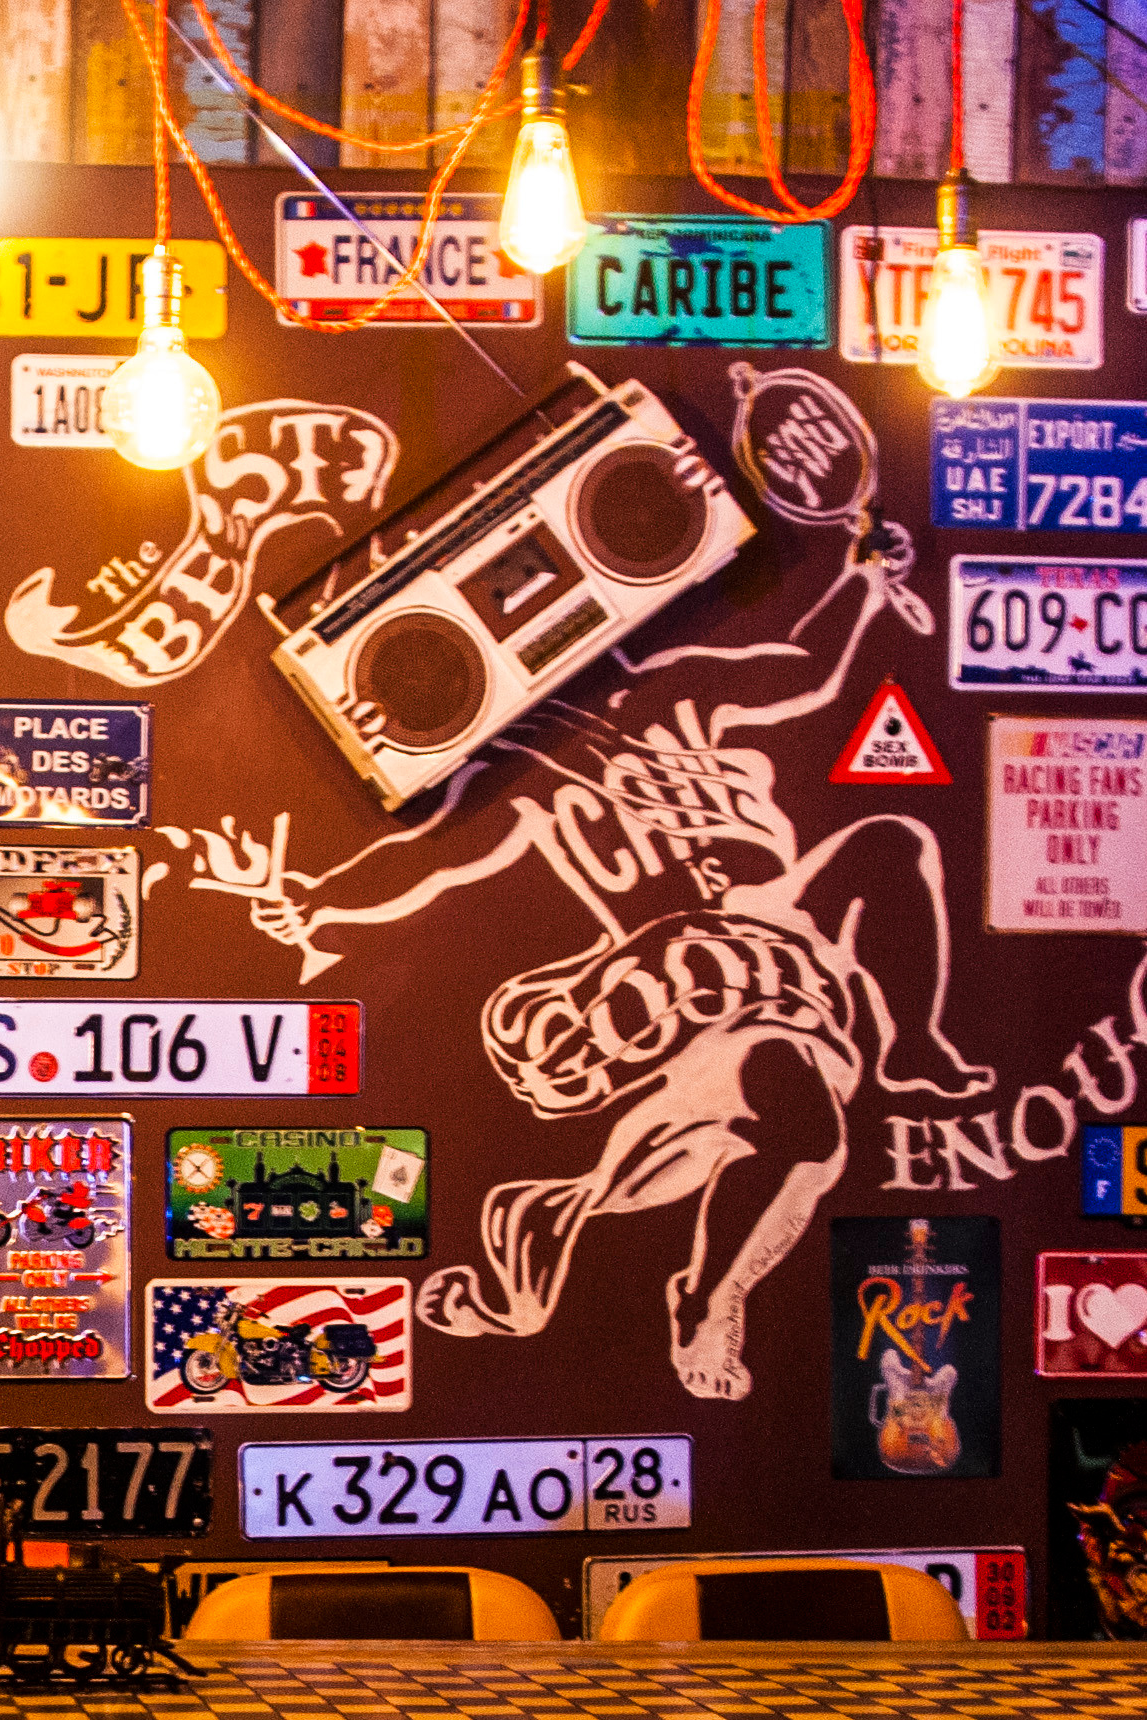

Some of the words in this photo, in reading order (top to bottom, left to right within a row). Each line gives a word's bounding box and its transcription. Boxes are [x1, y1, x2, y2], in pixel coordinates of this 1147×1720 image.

[332, 234, 488, 286] FRANCE
[596, 254, 795, 319] CARIBE
[1028, 418, 1116, 450] EXPORT
[945, 466, 1007, 493] UAE
[951, 497, 1003, 521] SHJ
[86, 540, 164, 603] The
[1035, 566, 1121, 590] TEXAS
[967, 588, 1067, 654] 609
[13, 716, 110, 741] PLACE
[31, 750, 91, 774] DES
[871, 740, 908, 754] SEX
[1003, 763, 1082, 796] RACING
[1088, 765, 1143, 797] FANS
[1026, 798, 1120, 830] PARKING
[1046, 834, 1100, 865] ONLY
[72, 1013, 207, 1083] 106
[240, 1013, 284, 1083] V
[235, 1130, 361, 1148] CASINO
[1095, 1179, 1111, 1199] F
[856, 1276, 974, 1374] Rock
[1041, 1283, 1076, 1342] I
[32, 1441, 197, 1521] 2177
[592, 1446, 664, 1500] 28
[276, 1472, 315, 1528] K
[332, 1453, 465, 1525] 329
[481, 1467, 573, 1523] AO
[604, 1503, 658, 1523] RUS
